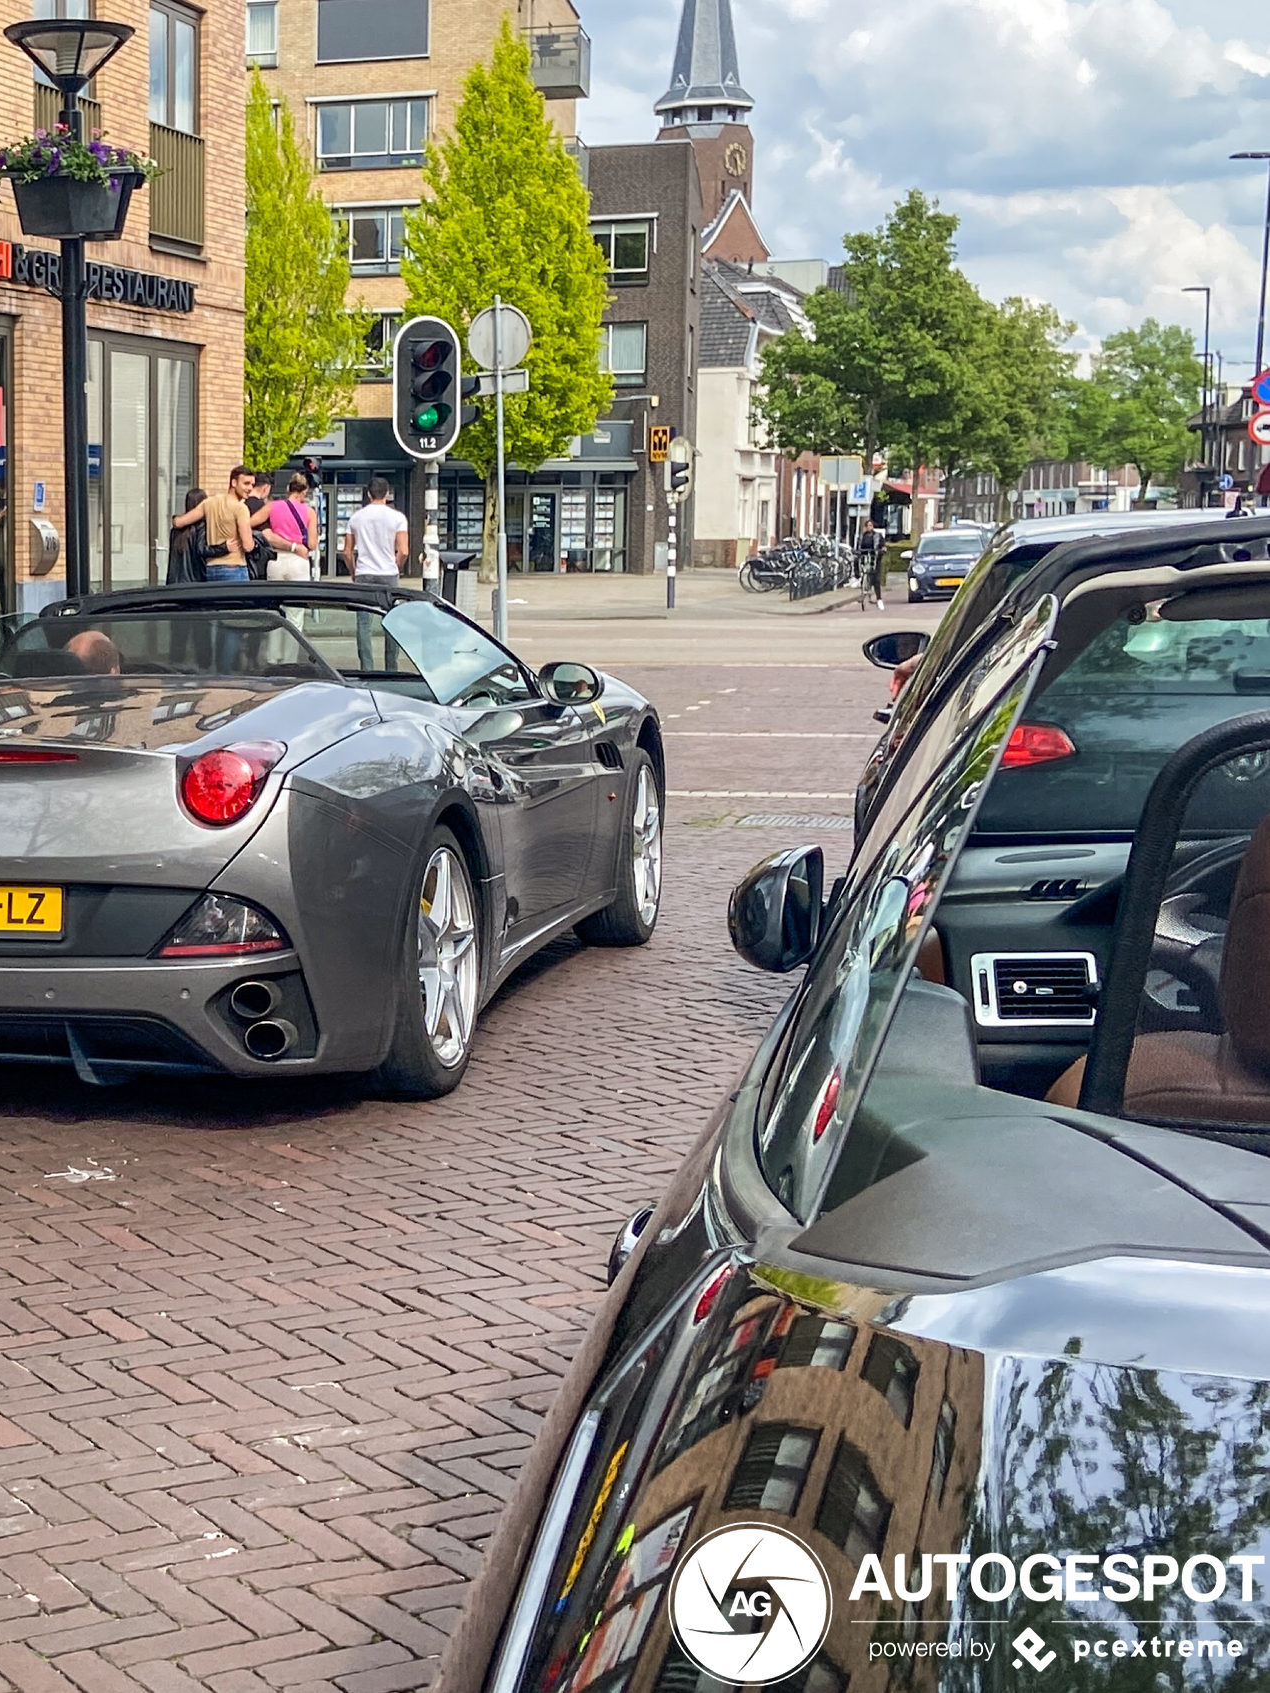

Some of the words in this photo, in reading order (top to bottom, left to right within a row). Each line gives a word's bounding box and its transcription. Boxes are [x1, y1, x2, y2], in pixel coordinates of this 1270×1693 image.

[12, 243, 30, 282] &
[85, 262, 198, 313] RESTAURANT
[419, 437, 437, 449] 11.2
